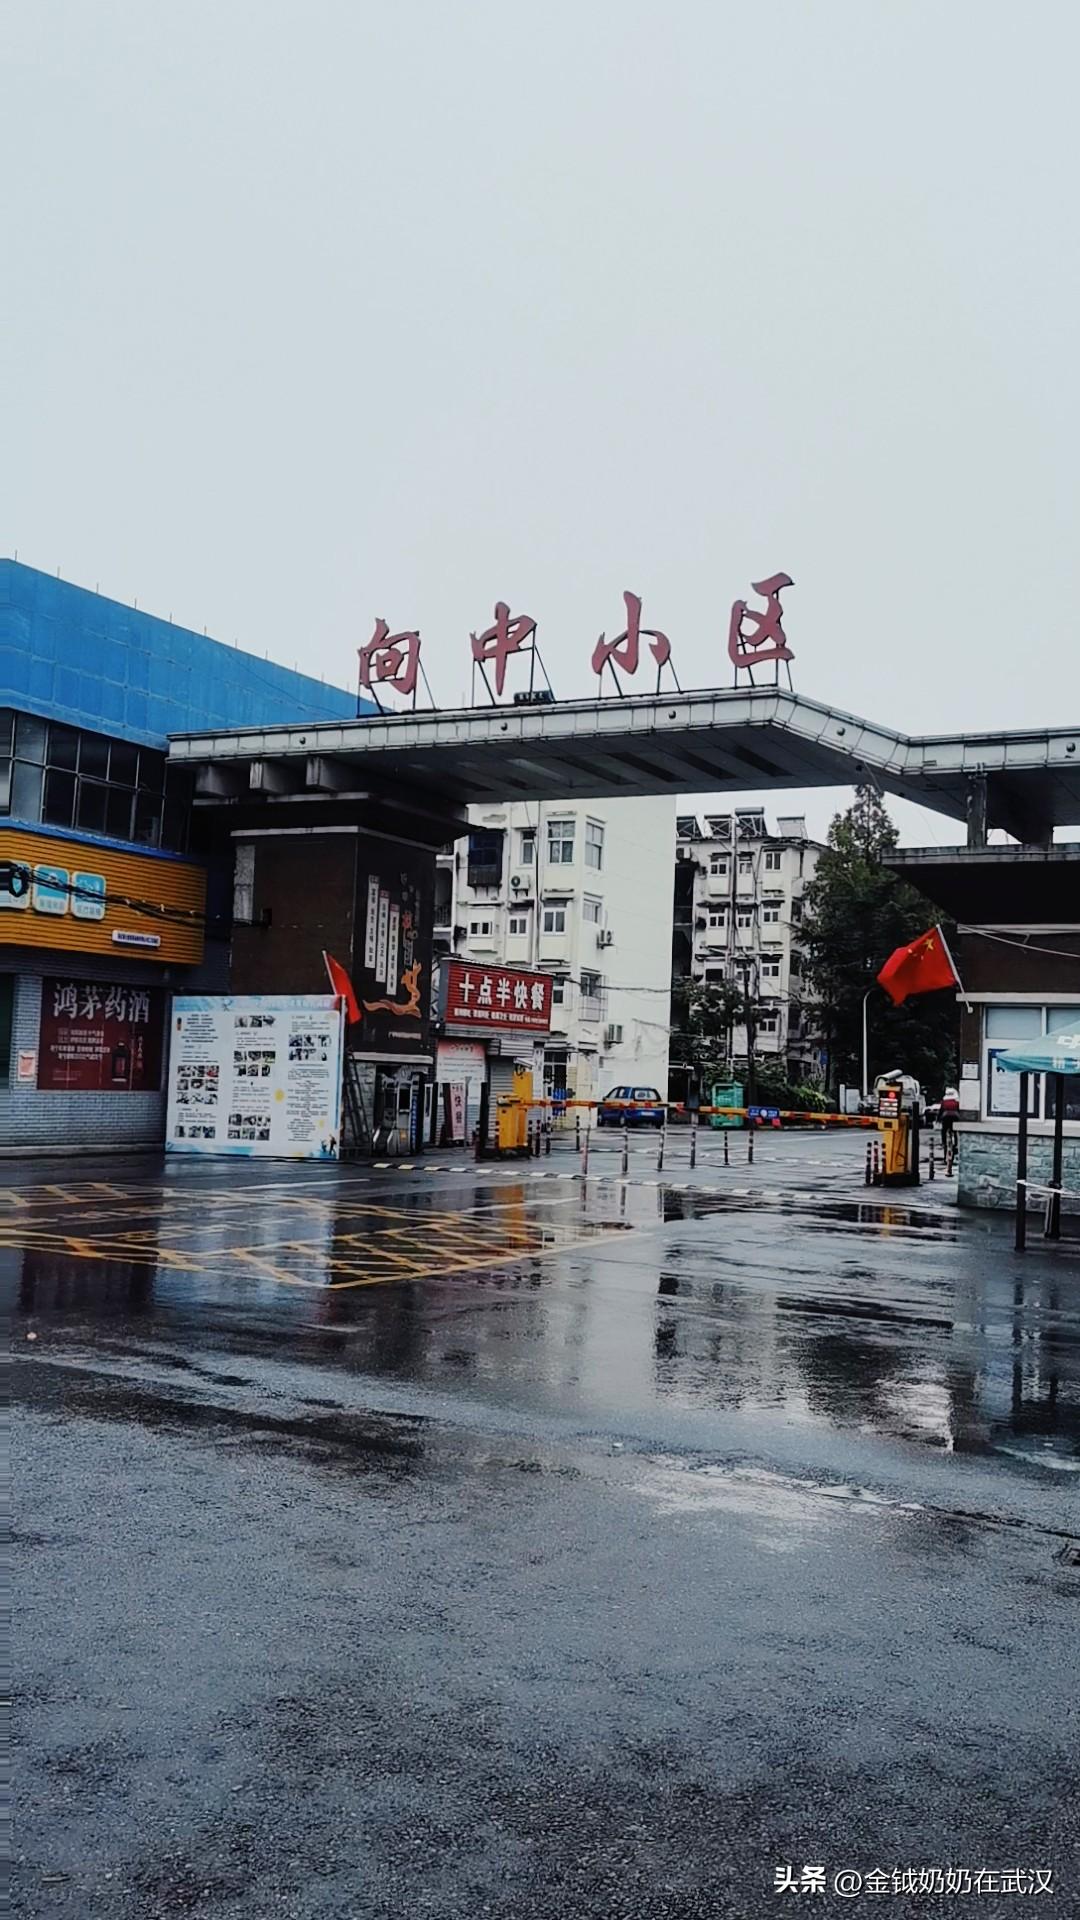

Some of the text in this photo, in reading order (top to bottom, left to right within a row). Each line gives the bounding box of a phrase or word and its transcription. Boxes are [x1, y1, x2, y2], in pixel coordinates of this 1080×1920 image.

[357, 572, 795, 695] 向中小区
[53, 983, 151, 1023] 鸿茅药酒
[459, 972, 545, 1011] 十点半快餐
